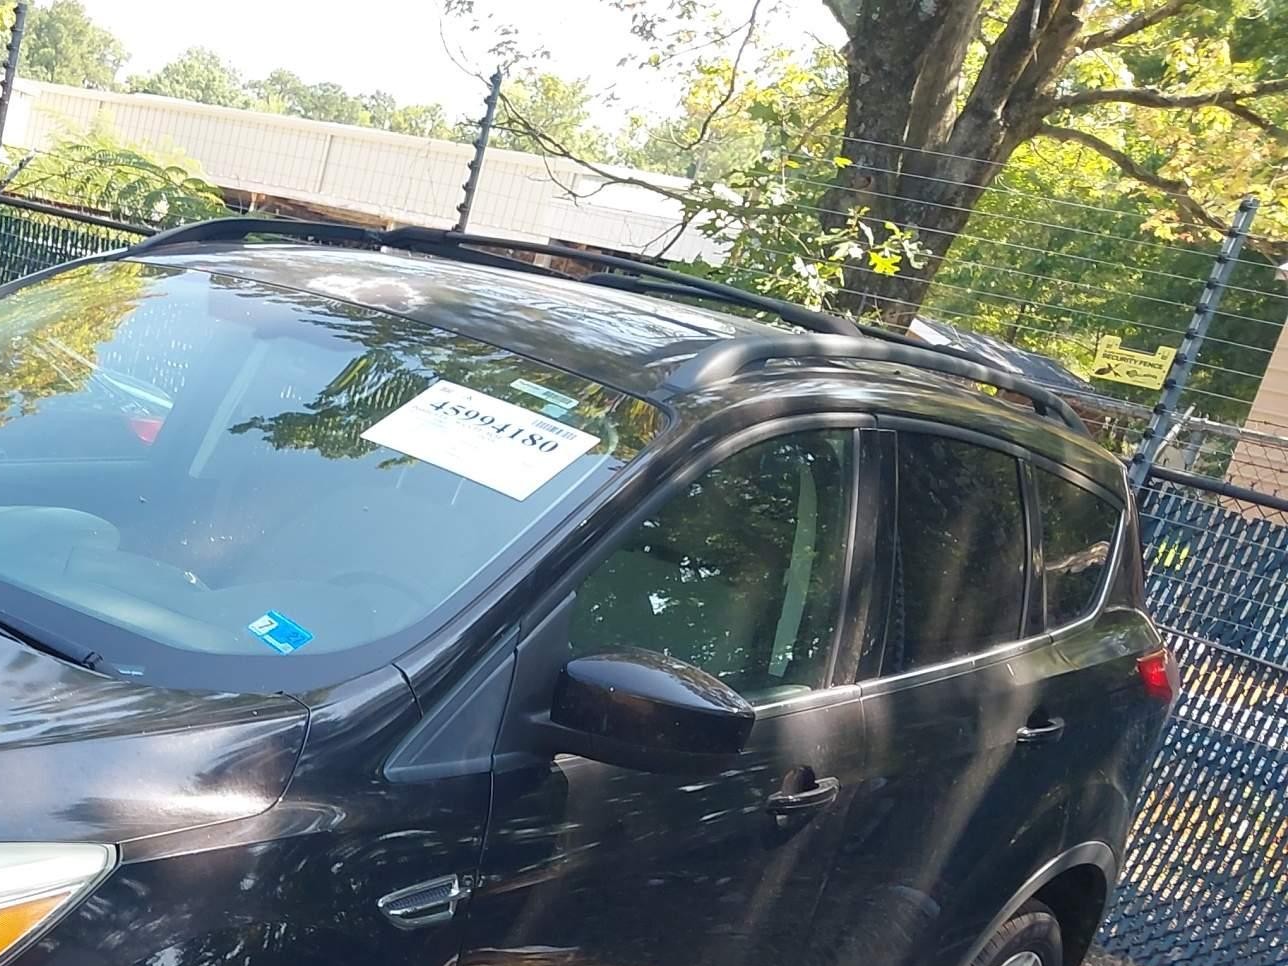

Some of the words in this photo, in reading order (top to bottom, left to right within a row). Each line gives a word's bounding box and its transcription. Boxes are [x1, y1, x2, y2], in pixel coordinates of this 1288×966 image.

[1102, 353, 1139, 365] SECURITY
[1139, 359, 1163, 370] FENCE
[430, 400, 559, 453] 45994180
